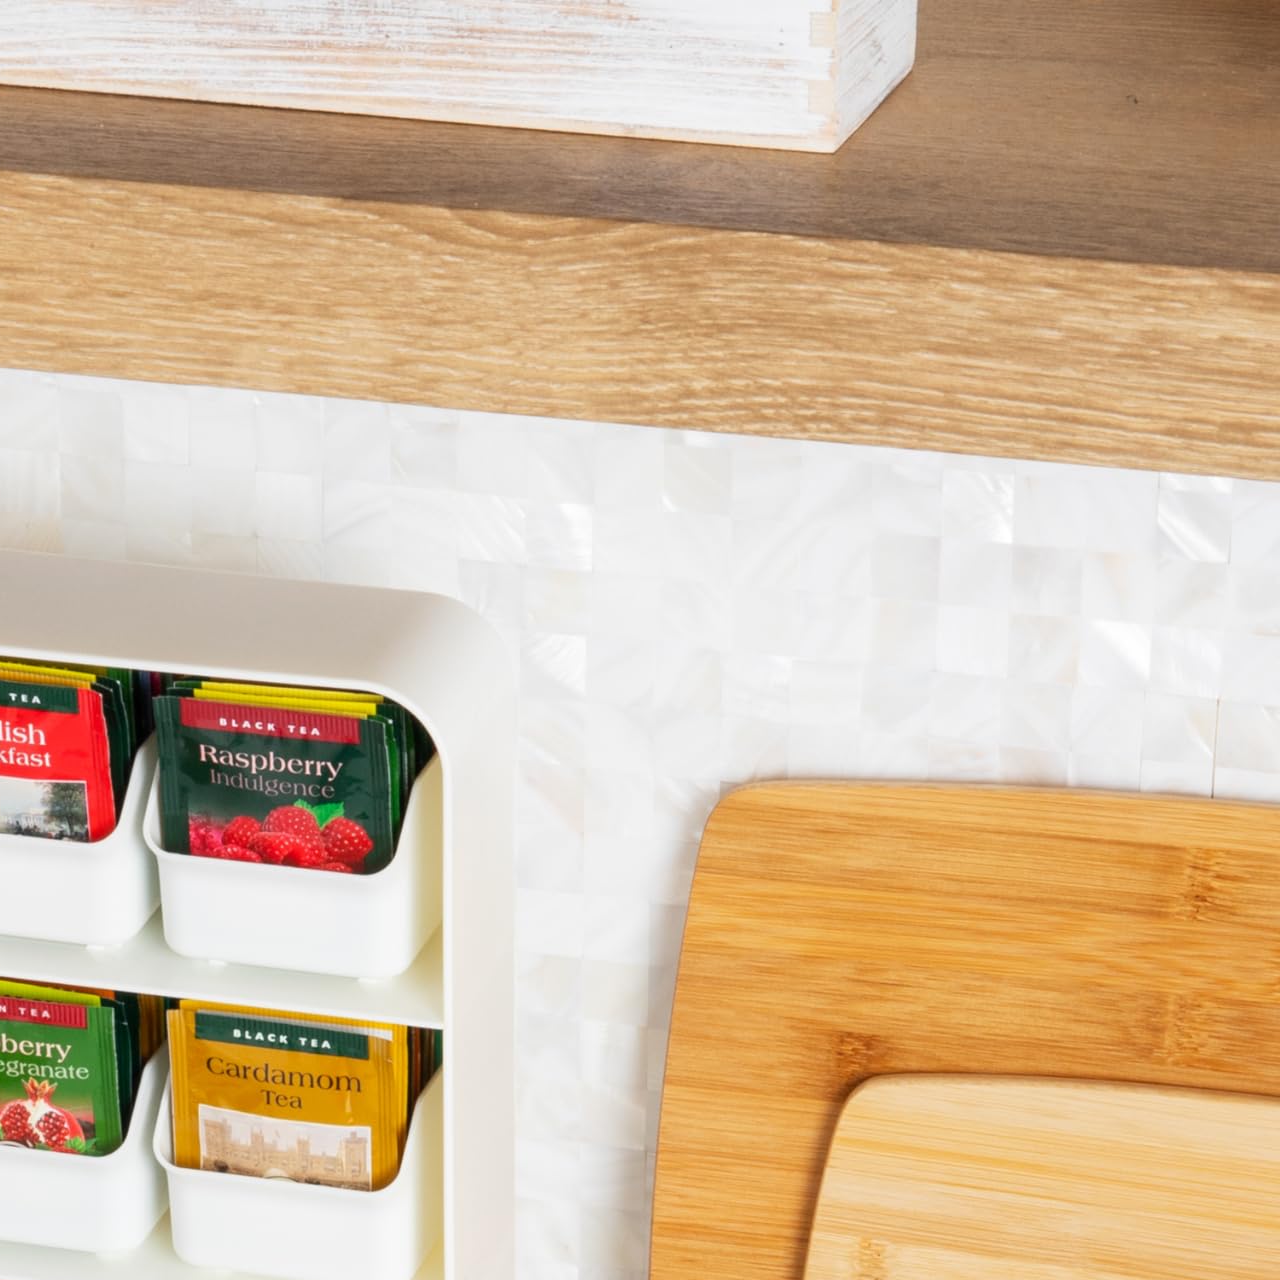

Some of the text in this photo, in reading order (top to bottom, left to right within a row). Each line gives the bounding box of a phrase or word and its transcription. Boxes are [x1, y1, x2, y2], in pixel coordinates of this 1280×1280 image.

[9, 693, 42, 704] TEA
[219, 718, 320, 736] BLACK TEA
[199, 744, 343, 782] Raspberry
[210, 769, 335, 799] Indulgence
[19, 1007, 52, 1018] TEA
[233, 1029, 332, 1049] BLACK TEA
[206, 1057, 362, 1093] Cardamom
[261, 1089, 303, 1110] Tea
